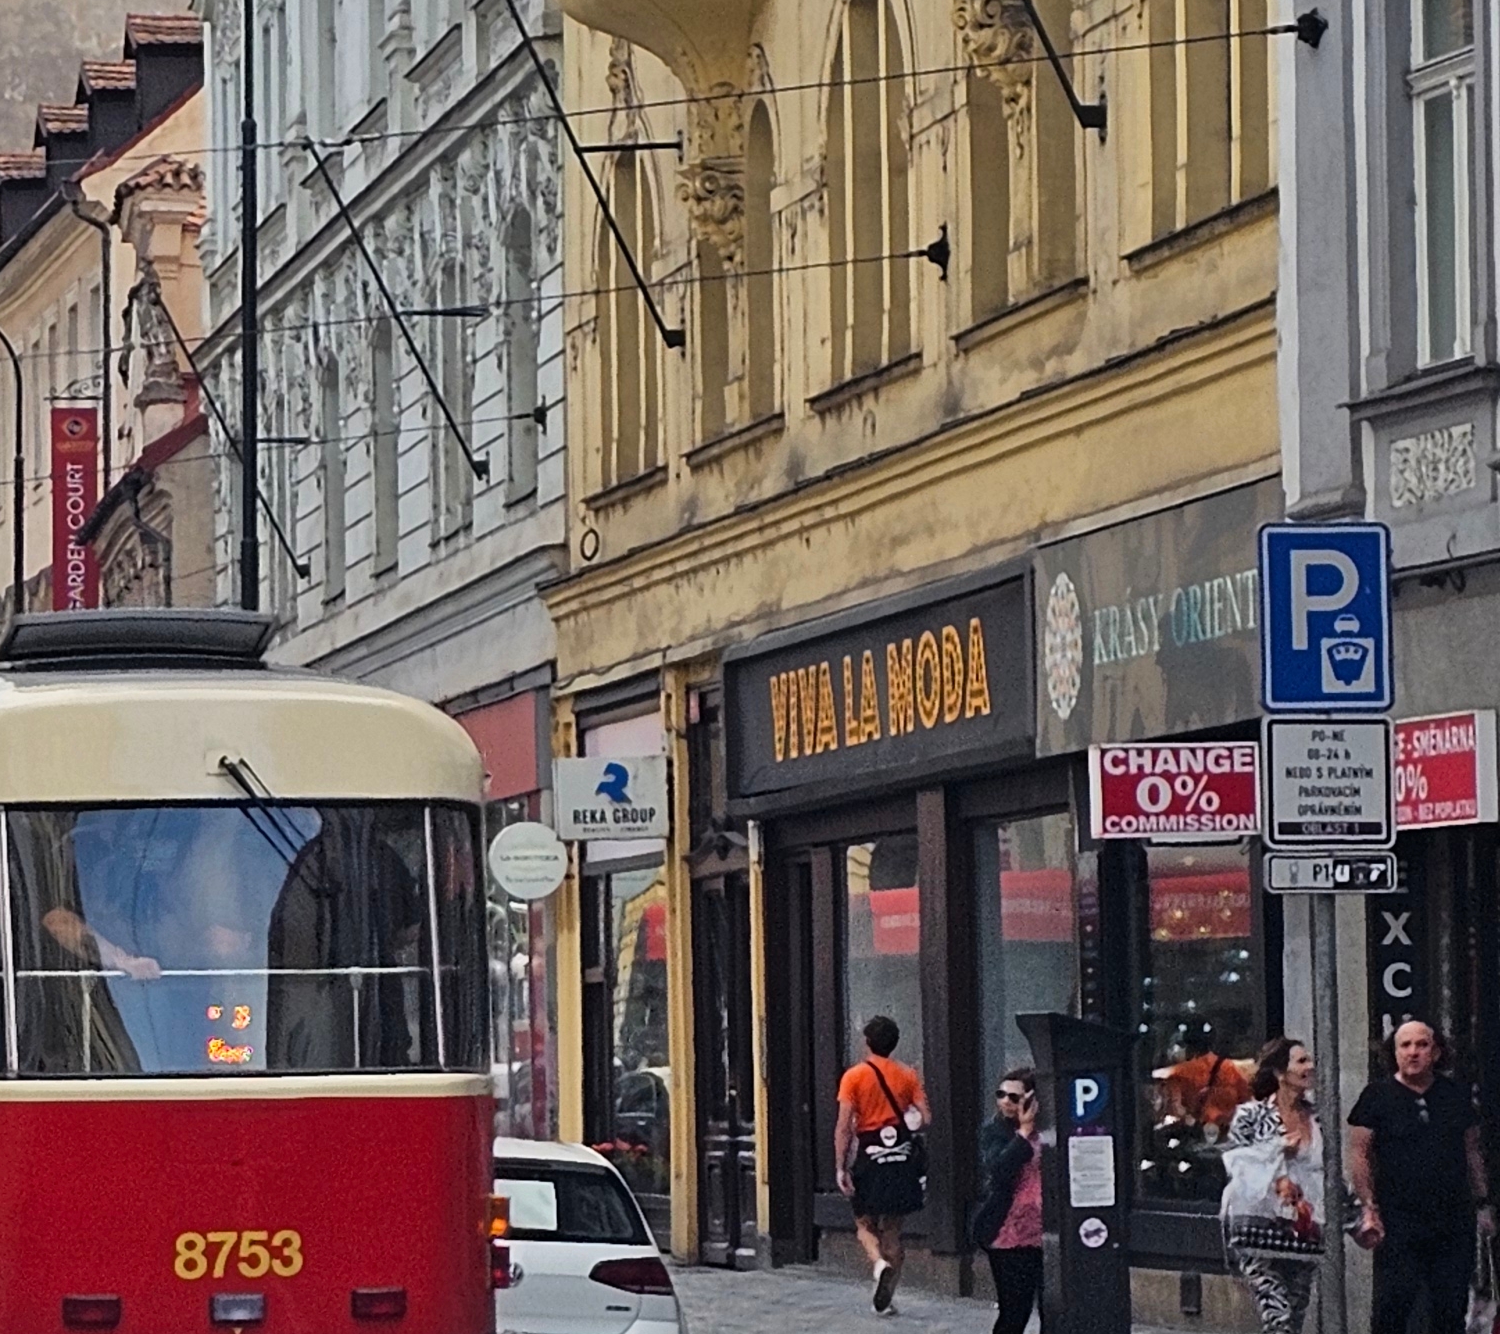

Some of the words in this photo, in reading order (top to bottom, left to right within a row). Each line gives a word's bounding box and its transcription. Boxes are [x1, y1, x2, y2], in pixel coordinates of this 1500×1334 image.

[66, 462, 85, 530] COURT
[1290, 549, 1359, 650] P
[1093, 586, 1163, 664] KRÁSY
[770, 661, 838, 762] VIVA
[843, 650, 881, 747] LA
[887, 617, 990, 736] MODA
[1103, 748, 1254, 775] CHANGE
[1285, 767, 1312, 779] NEBO
[1316, 767, 1323, 779] S
[1327, 764, 1373, 779] PLATNÝM
[1136, 774, 1220, 813] 0%
[1396, 763, 1428, 801] 0%
[573, 809, 607, 824] REKA
[613, 807, 656, 824] GROUP
[1105, 814, 1254, 832] COMMISSION
[1302, 823, 1348, 834] OBLAST
[1075, 1079, 1099, 1116] P
[174, 1229, 303, 1280] 8753
